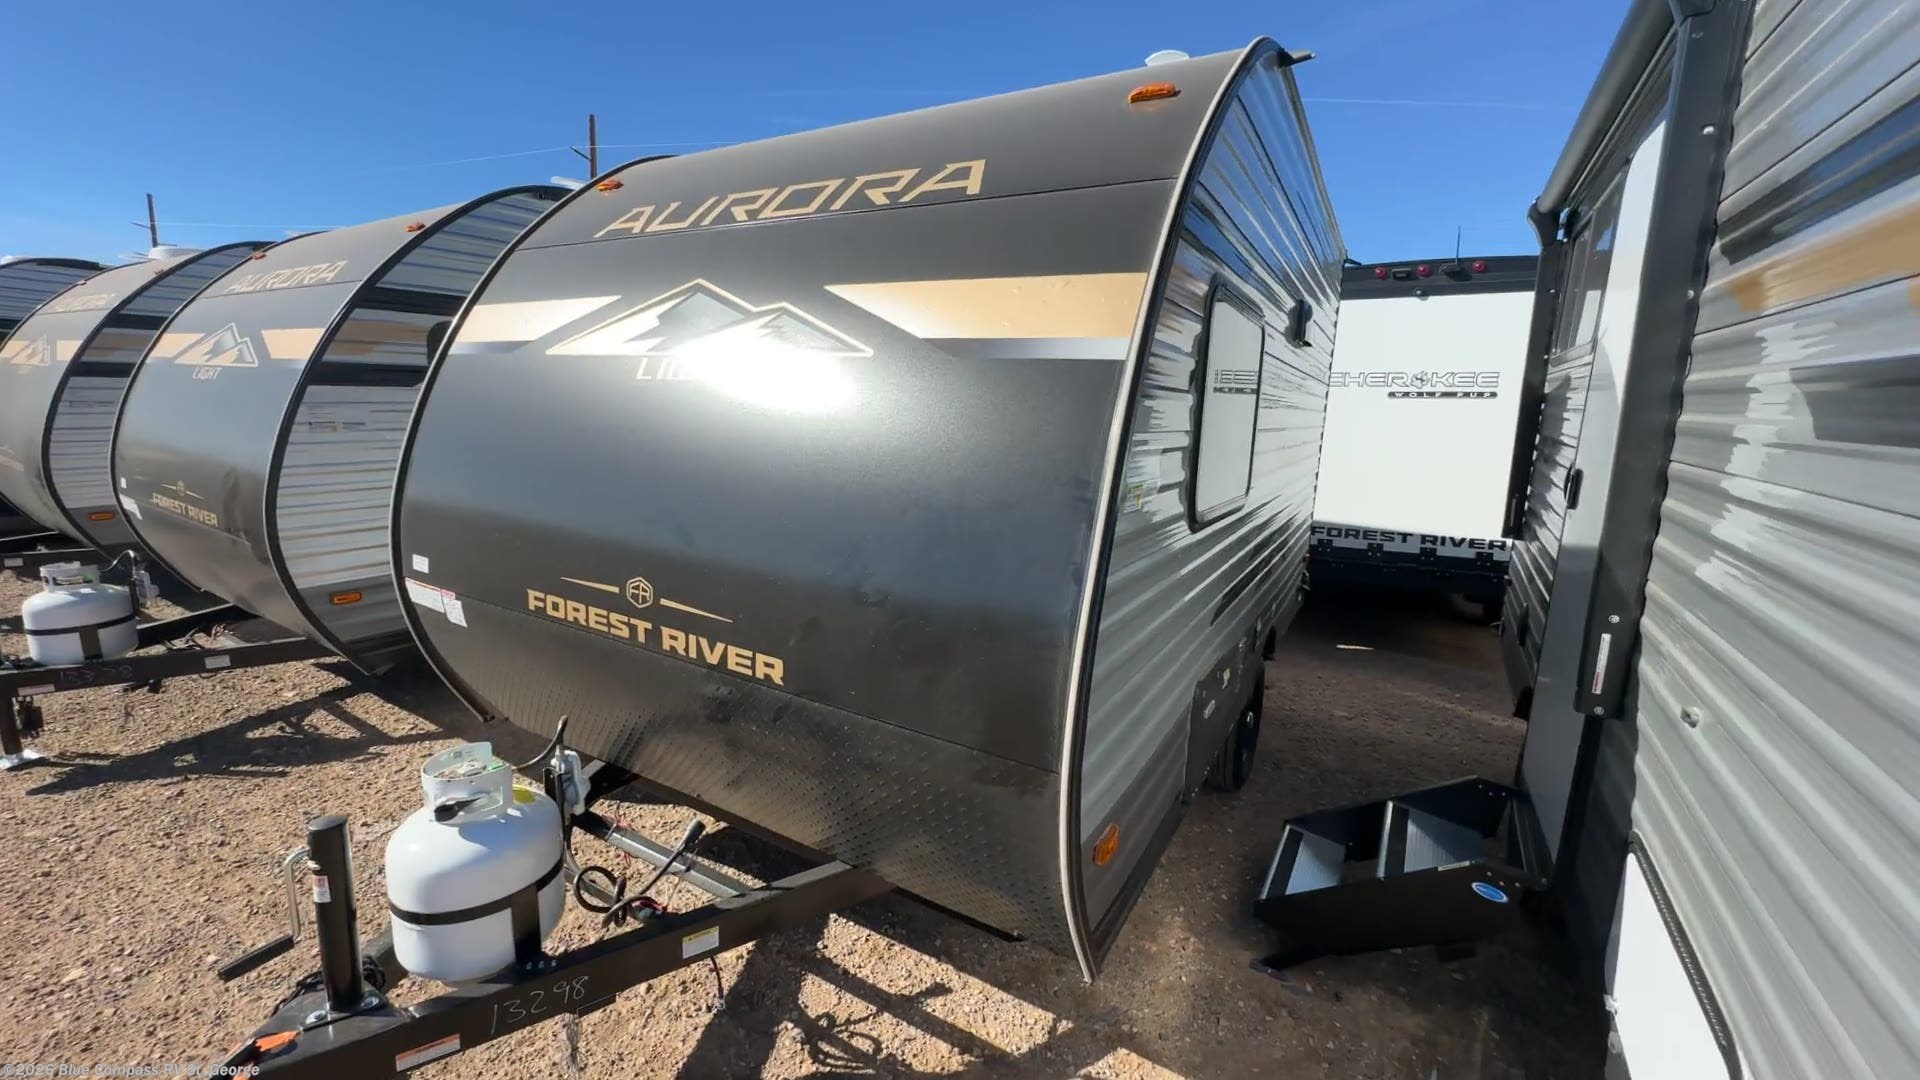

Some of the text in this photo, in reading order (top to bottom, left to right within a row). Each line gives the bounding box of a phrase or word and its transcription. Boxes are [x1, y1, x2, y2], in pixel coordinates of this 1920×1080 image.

[594, 159, 986, 238] AURORA
[227, 260, 347, 293] AURORA
[191, 366, 223, 380] LIGHT
[152, 492, 218, 527] FOREST RIVER
[1311, 525, 1507, 551] FOREST RIVER
[526, 588, 653, 644] FOREST
[660, 625, 785, 686] RIVER
